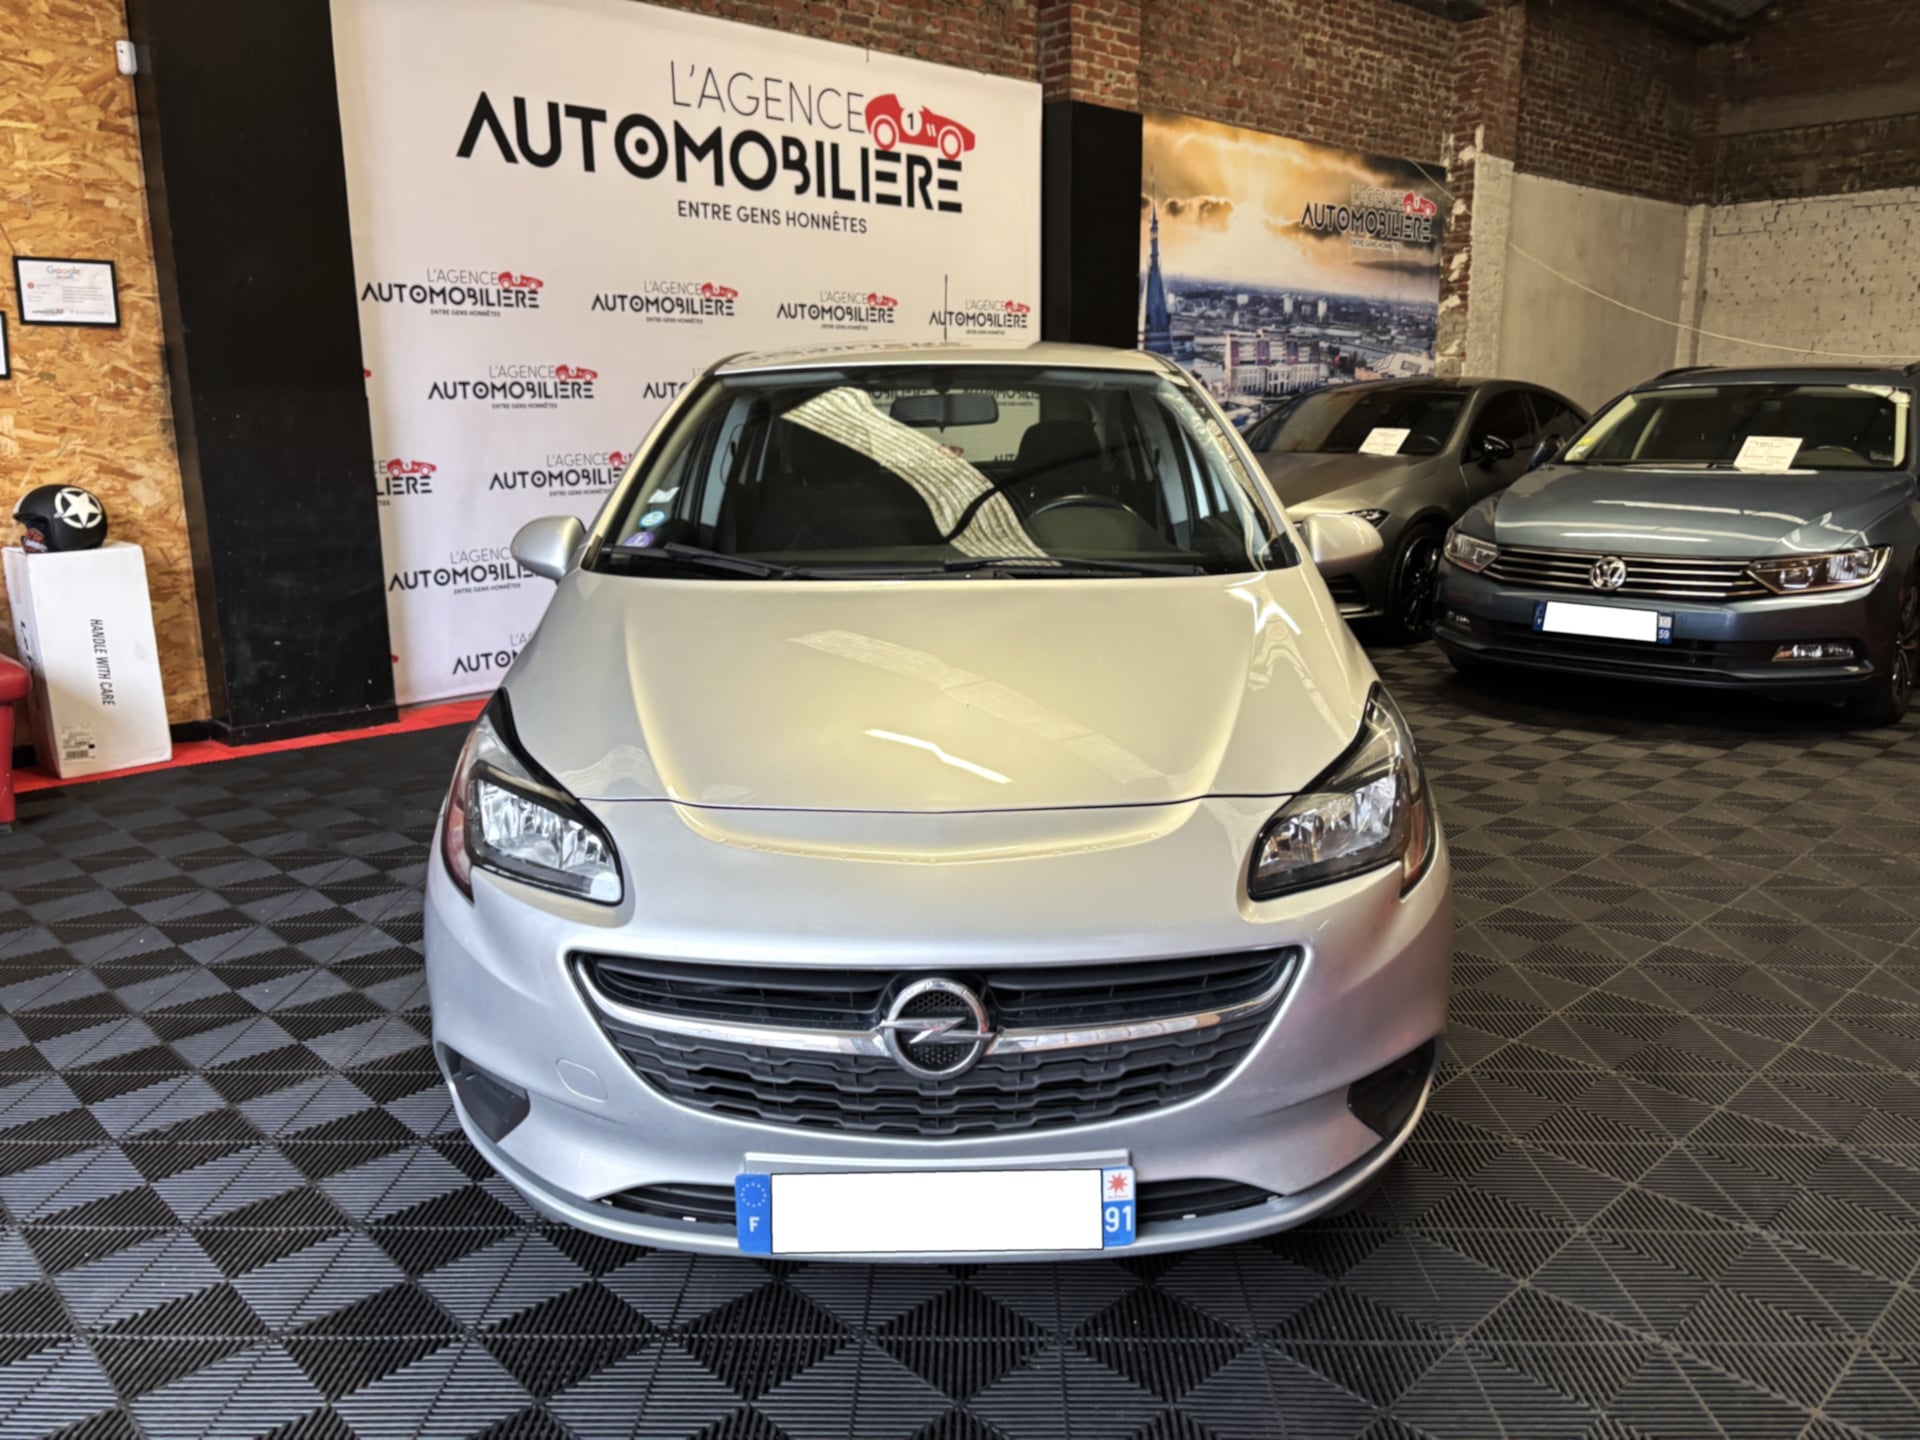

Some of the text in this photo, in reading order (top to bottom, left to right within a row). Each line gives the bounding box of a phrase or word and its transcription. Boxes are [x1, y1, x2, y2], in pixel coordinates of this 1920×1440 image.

[670, 60, 866, 134] L'AGENCE
[677, 200, 868, 234] ENTRE GENS HONNÊTES
[449, 546, 513, 565] L'AGENC
[1658, 629, 1671, 640] 59
[89, 619, 116, 707] HANDLE WITH CARE
[748, 1216, 760, 1233] F
[1104, 1205, 1133, 1233] 91
